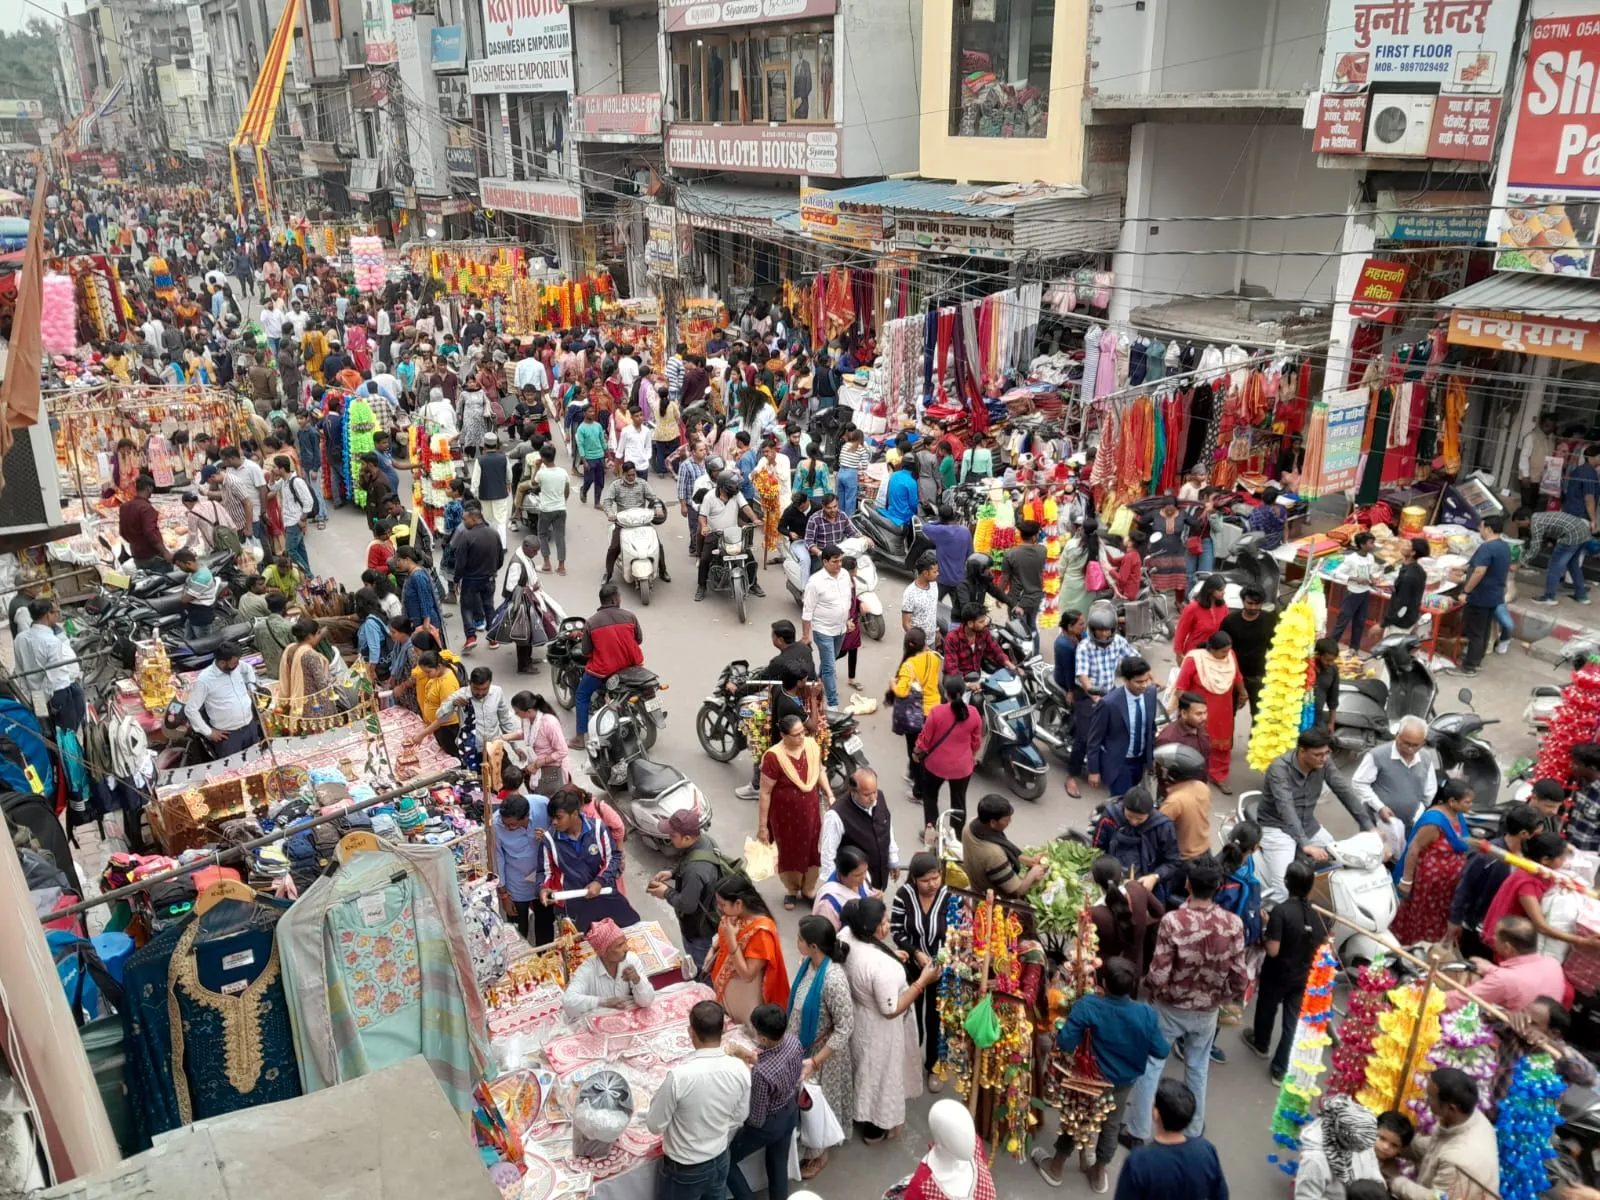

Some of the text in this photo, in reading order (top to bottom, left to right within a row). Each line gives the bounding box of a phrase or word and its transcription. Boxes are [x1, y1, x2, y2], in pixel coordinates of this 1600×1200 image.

[488, 33, 569, 56] DASHMESH EMPORIUM
[1375, 44, 1453, 58] FIRST FLOOR
[472, 59, 569, 83] DASHMESH EMPORIUM
[1528, 50, 1600, 115] Sh
[630, 95, 645, 113] SALE
[669, 137, 806, 169] CHILANA CLOTH HOUSE
[483, 186, 580, 217] DASHMESH EMPORIUM
[1365, 267, 1405, 283] महारानी
